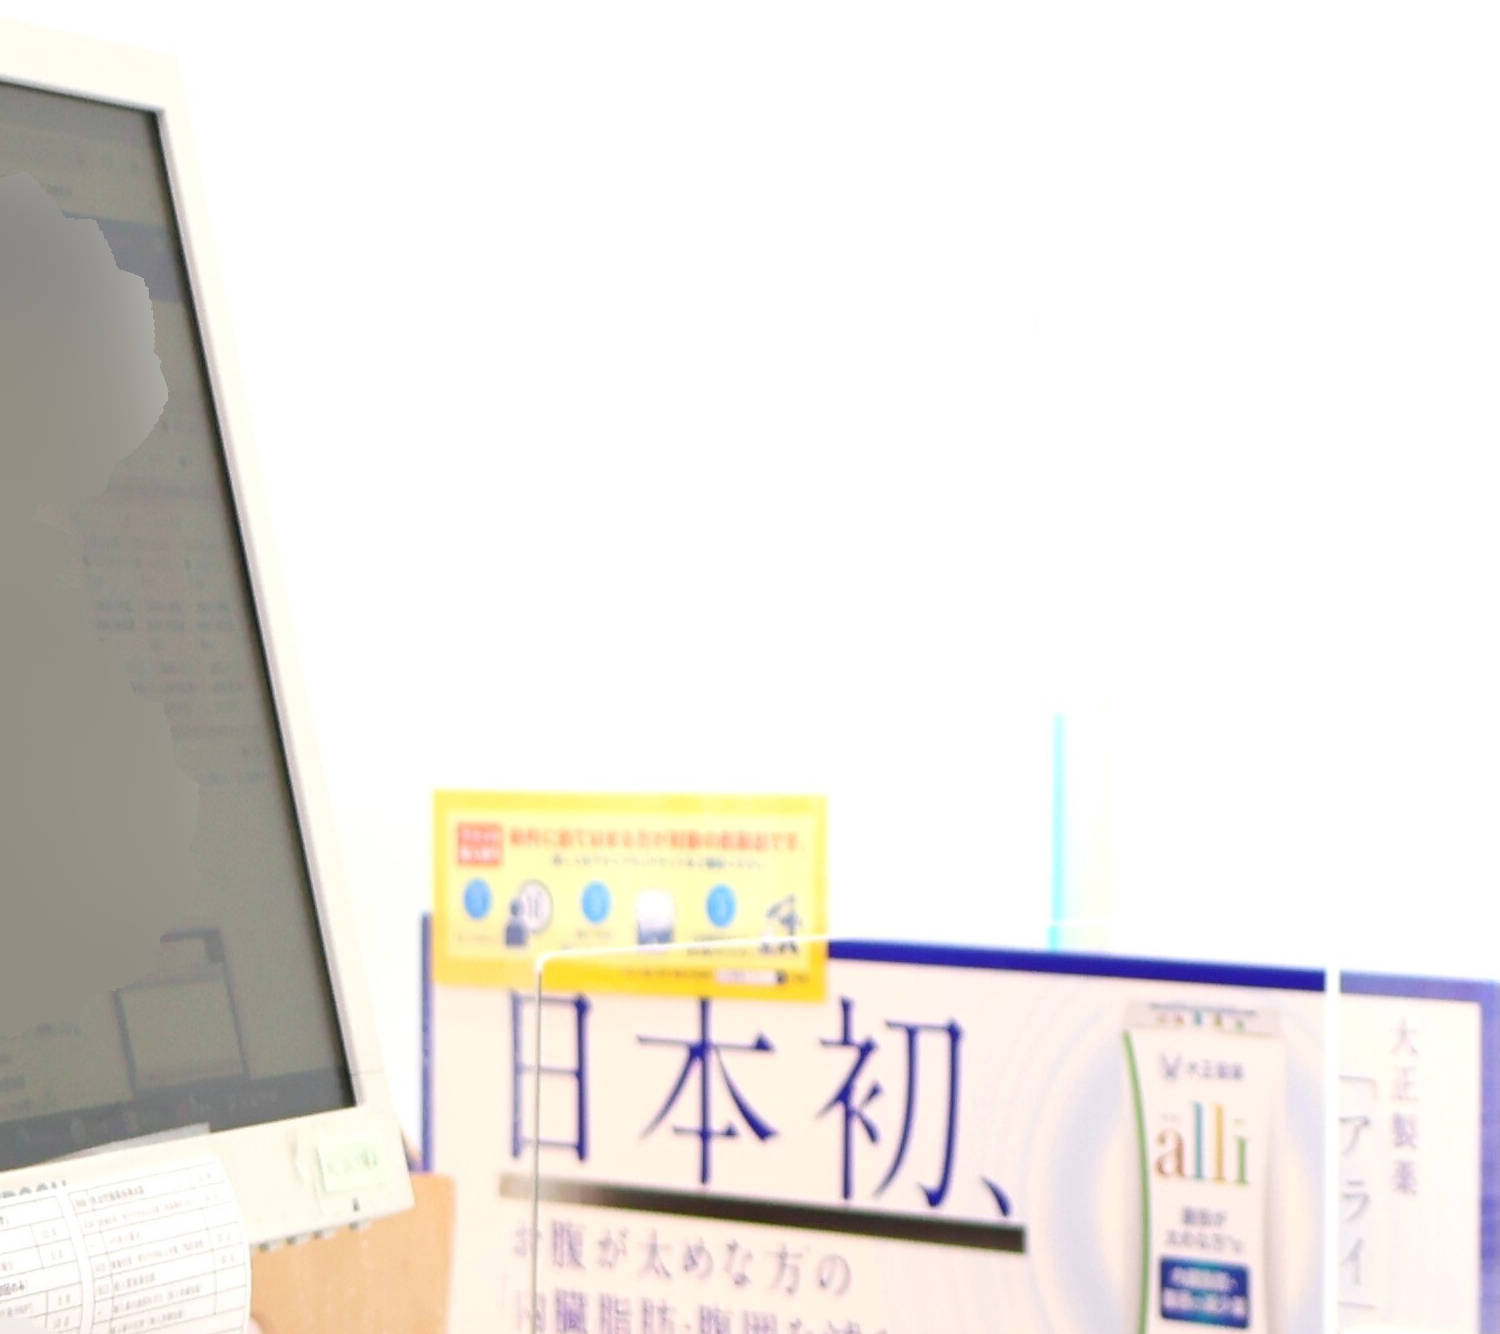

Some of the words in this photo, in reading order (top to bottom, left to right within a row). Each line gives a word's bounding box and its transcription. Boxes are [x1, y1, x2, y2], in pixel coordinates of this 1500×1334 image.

[1155, 1099, 1250, 1188] alli
[1390, 1017, 1420, 1197] 大正製薬
